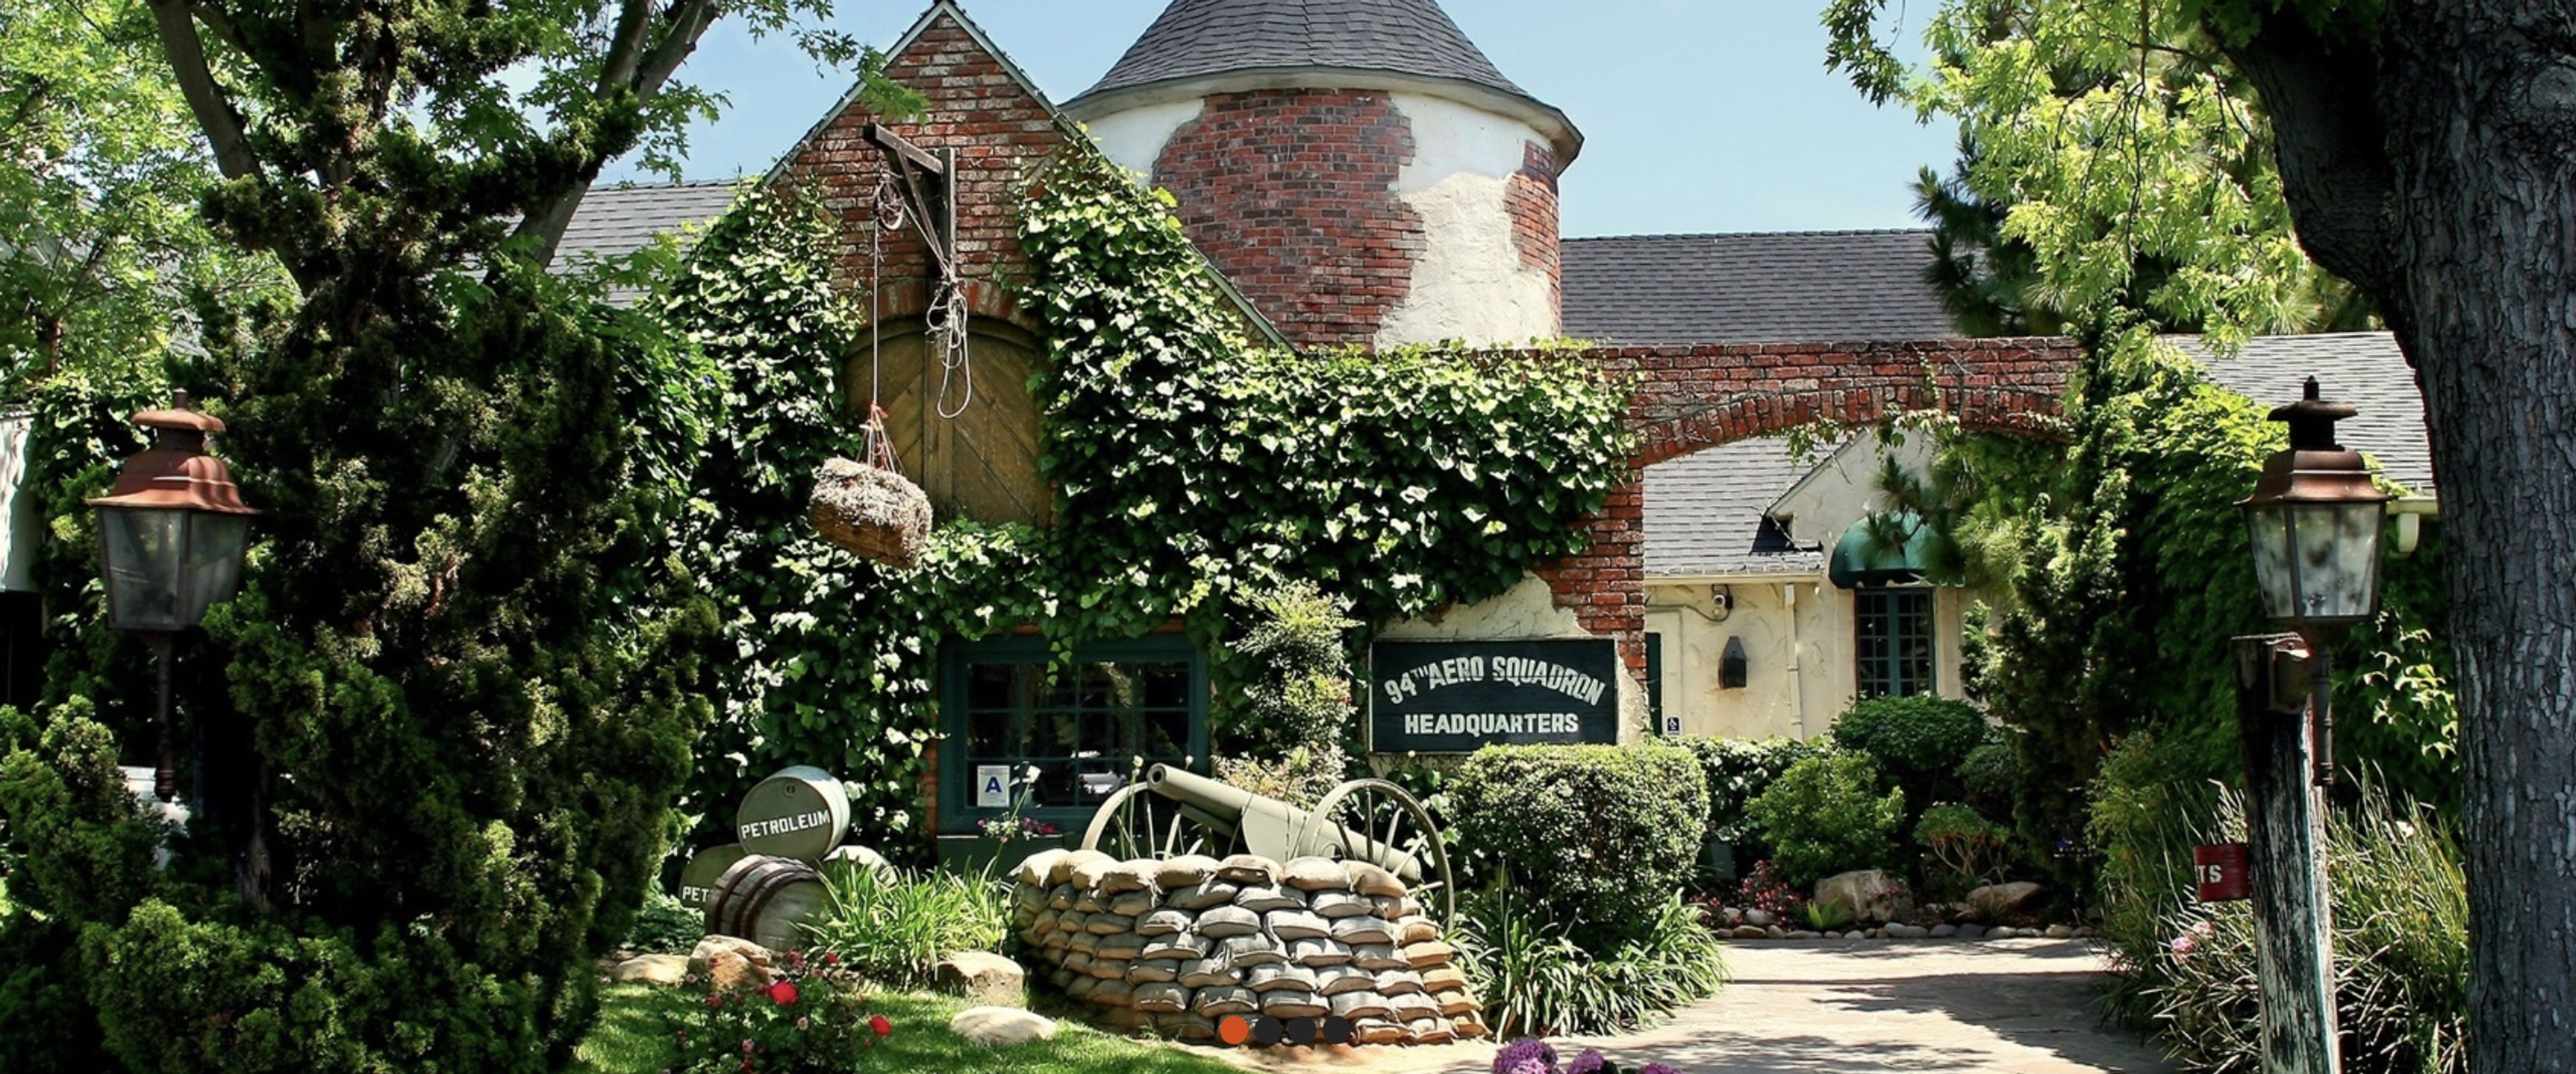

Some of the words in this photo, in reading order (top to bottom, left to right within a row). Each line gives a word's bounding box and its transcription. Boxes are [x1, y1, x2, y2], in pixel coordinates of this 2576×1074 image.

[1428, 655, 1484, 690] AERO
[1492, 655, 1605, 706] SQUADRON
[1405, 713, 1578, 737] HEADQUARTERS
[985, 776, 1002, 793] A
[741, 809, 830, 839] PETROLEUM
[2195, 865, 2222, 883] TS
[682, 886, 714, 902] PET
